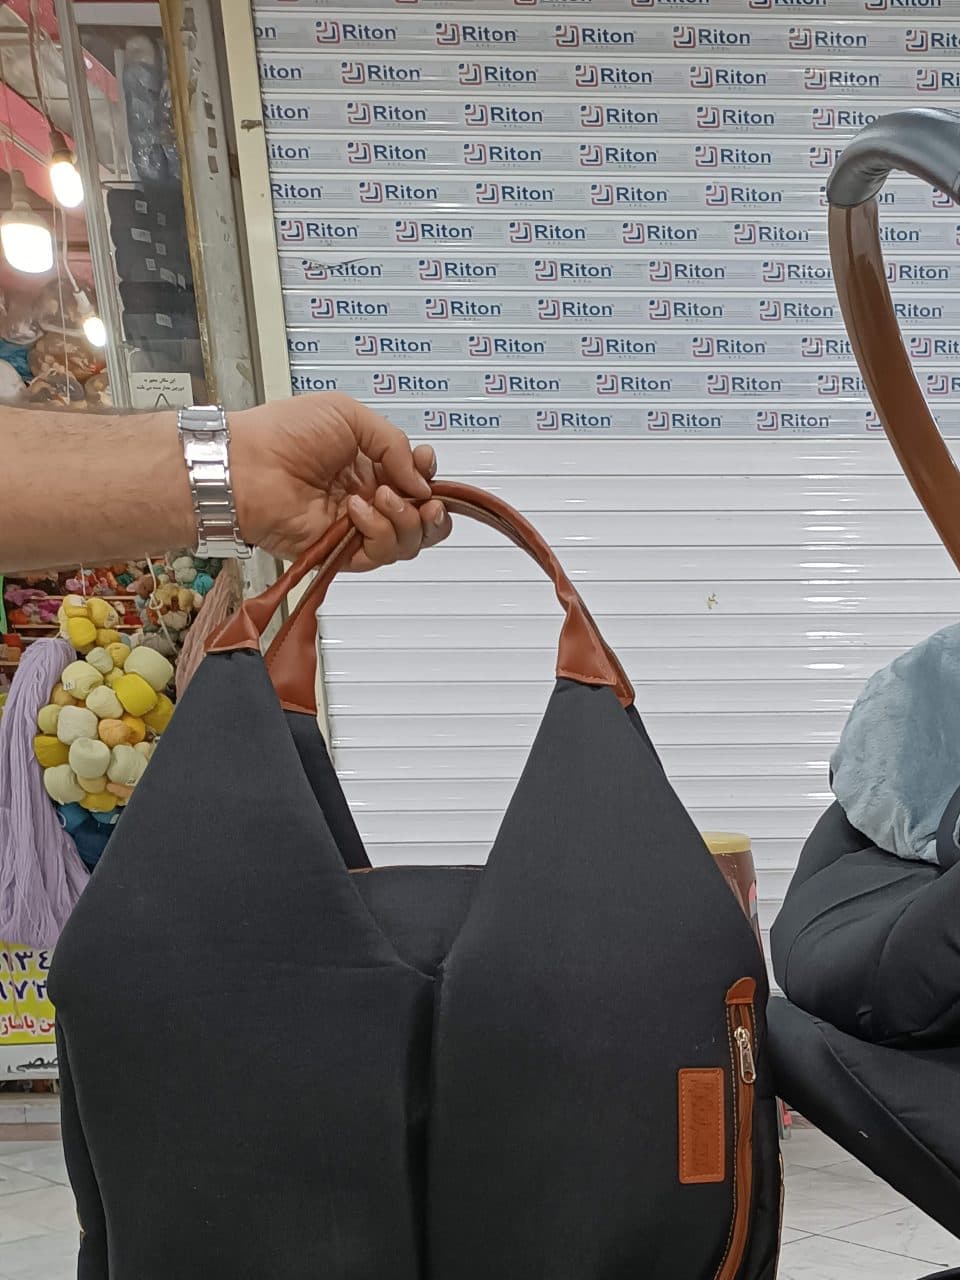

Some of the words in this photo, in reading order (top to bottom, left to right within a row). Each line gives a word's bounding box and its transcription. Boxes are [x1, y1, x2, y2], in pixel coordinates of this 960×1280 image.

[343, 24, 396, 40] Riton
[462, 26, 516, 42] Riton
[582, 28, 634, 43] Riton
[699, 29, 750, 45] Riton
[815, 31, 867, 47] Riton
[264, 64, 301, 79] iton
[368, 65, 420, 81] Riton
[485, 66, 537, 82] Riton
[601, 68, 652, 83] Riton
[716, 70, 766, 84] Riton
[830, 71, 880, 86] Riton
[374, 105, 426, 120] Riton
[491, 107, 543, 122] Riton
[606, 109, 658, 124] Riton
[723, 110, 774, 124] Riton
[838, 111, 874, 126] Rito
[272, 144, 309, 159] iton
[374, 145, 426, 160] Riton
[489, 146, 541, 161] Riton
[605, 148, 657, 162] Riton
[721, 149, 771, 163] Riton
[271, 184, 322, 199] Riton
[385, 184, 437, 199] Riton
[502, 186, 553, 201] Riton
[616, 187, 667, 202] Riton
[731, 188, 782, 202] Riton
[307, 223, 358, 238] Riton
[421, 224, 472, 239] Riton
[535, 225, 586, 239] Riton
[647, 225, 697, 240] Riton
[759, 227, 809, 241] Riton
[881, 227, 919, 241] iton
[328, 262, 381, 276] Riton
[445, 262, 496, 277] Riton
[560, 263, 612, 278] Riton
[675, 264, 725, 279] Riton
[899, 265, 948, 279] Riton
[337, 301, 388, 315] Riton
[451, 302, 501, 316] Riton
[562, 302, 612, 317] Riton
[674, 303, 723, 317] Riton
[784, 303, 833, 318] Riton
[895, 303, 942, 318] Riton
[380, 339, 431, 353] Riton
[494, 339, 545, 353] Riton
[606, 339, 656, 353] Riton
[716, 340, 766, 353] Riton
[398, 376, 448, 390] Riton
[510, 376, 560, 391] Riton
[621, 376, 671, 391] Riton
[731, 377, 781, 391] Riton
[449, 413, 500, 427] Riton
[561, 413, 611, 427] Riton
[671, 413, 721, 428] Riton
[780, 413, 830, 428] Riton
